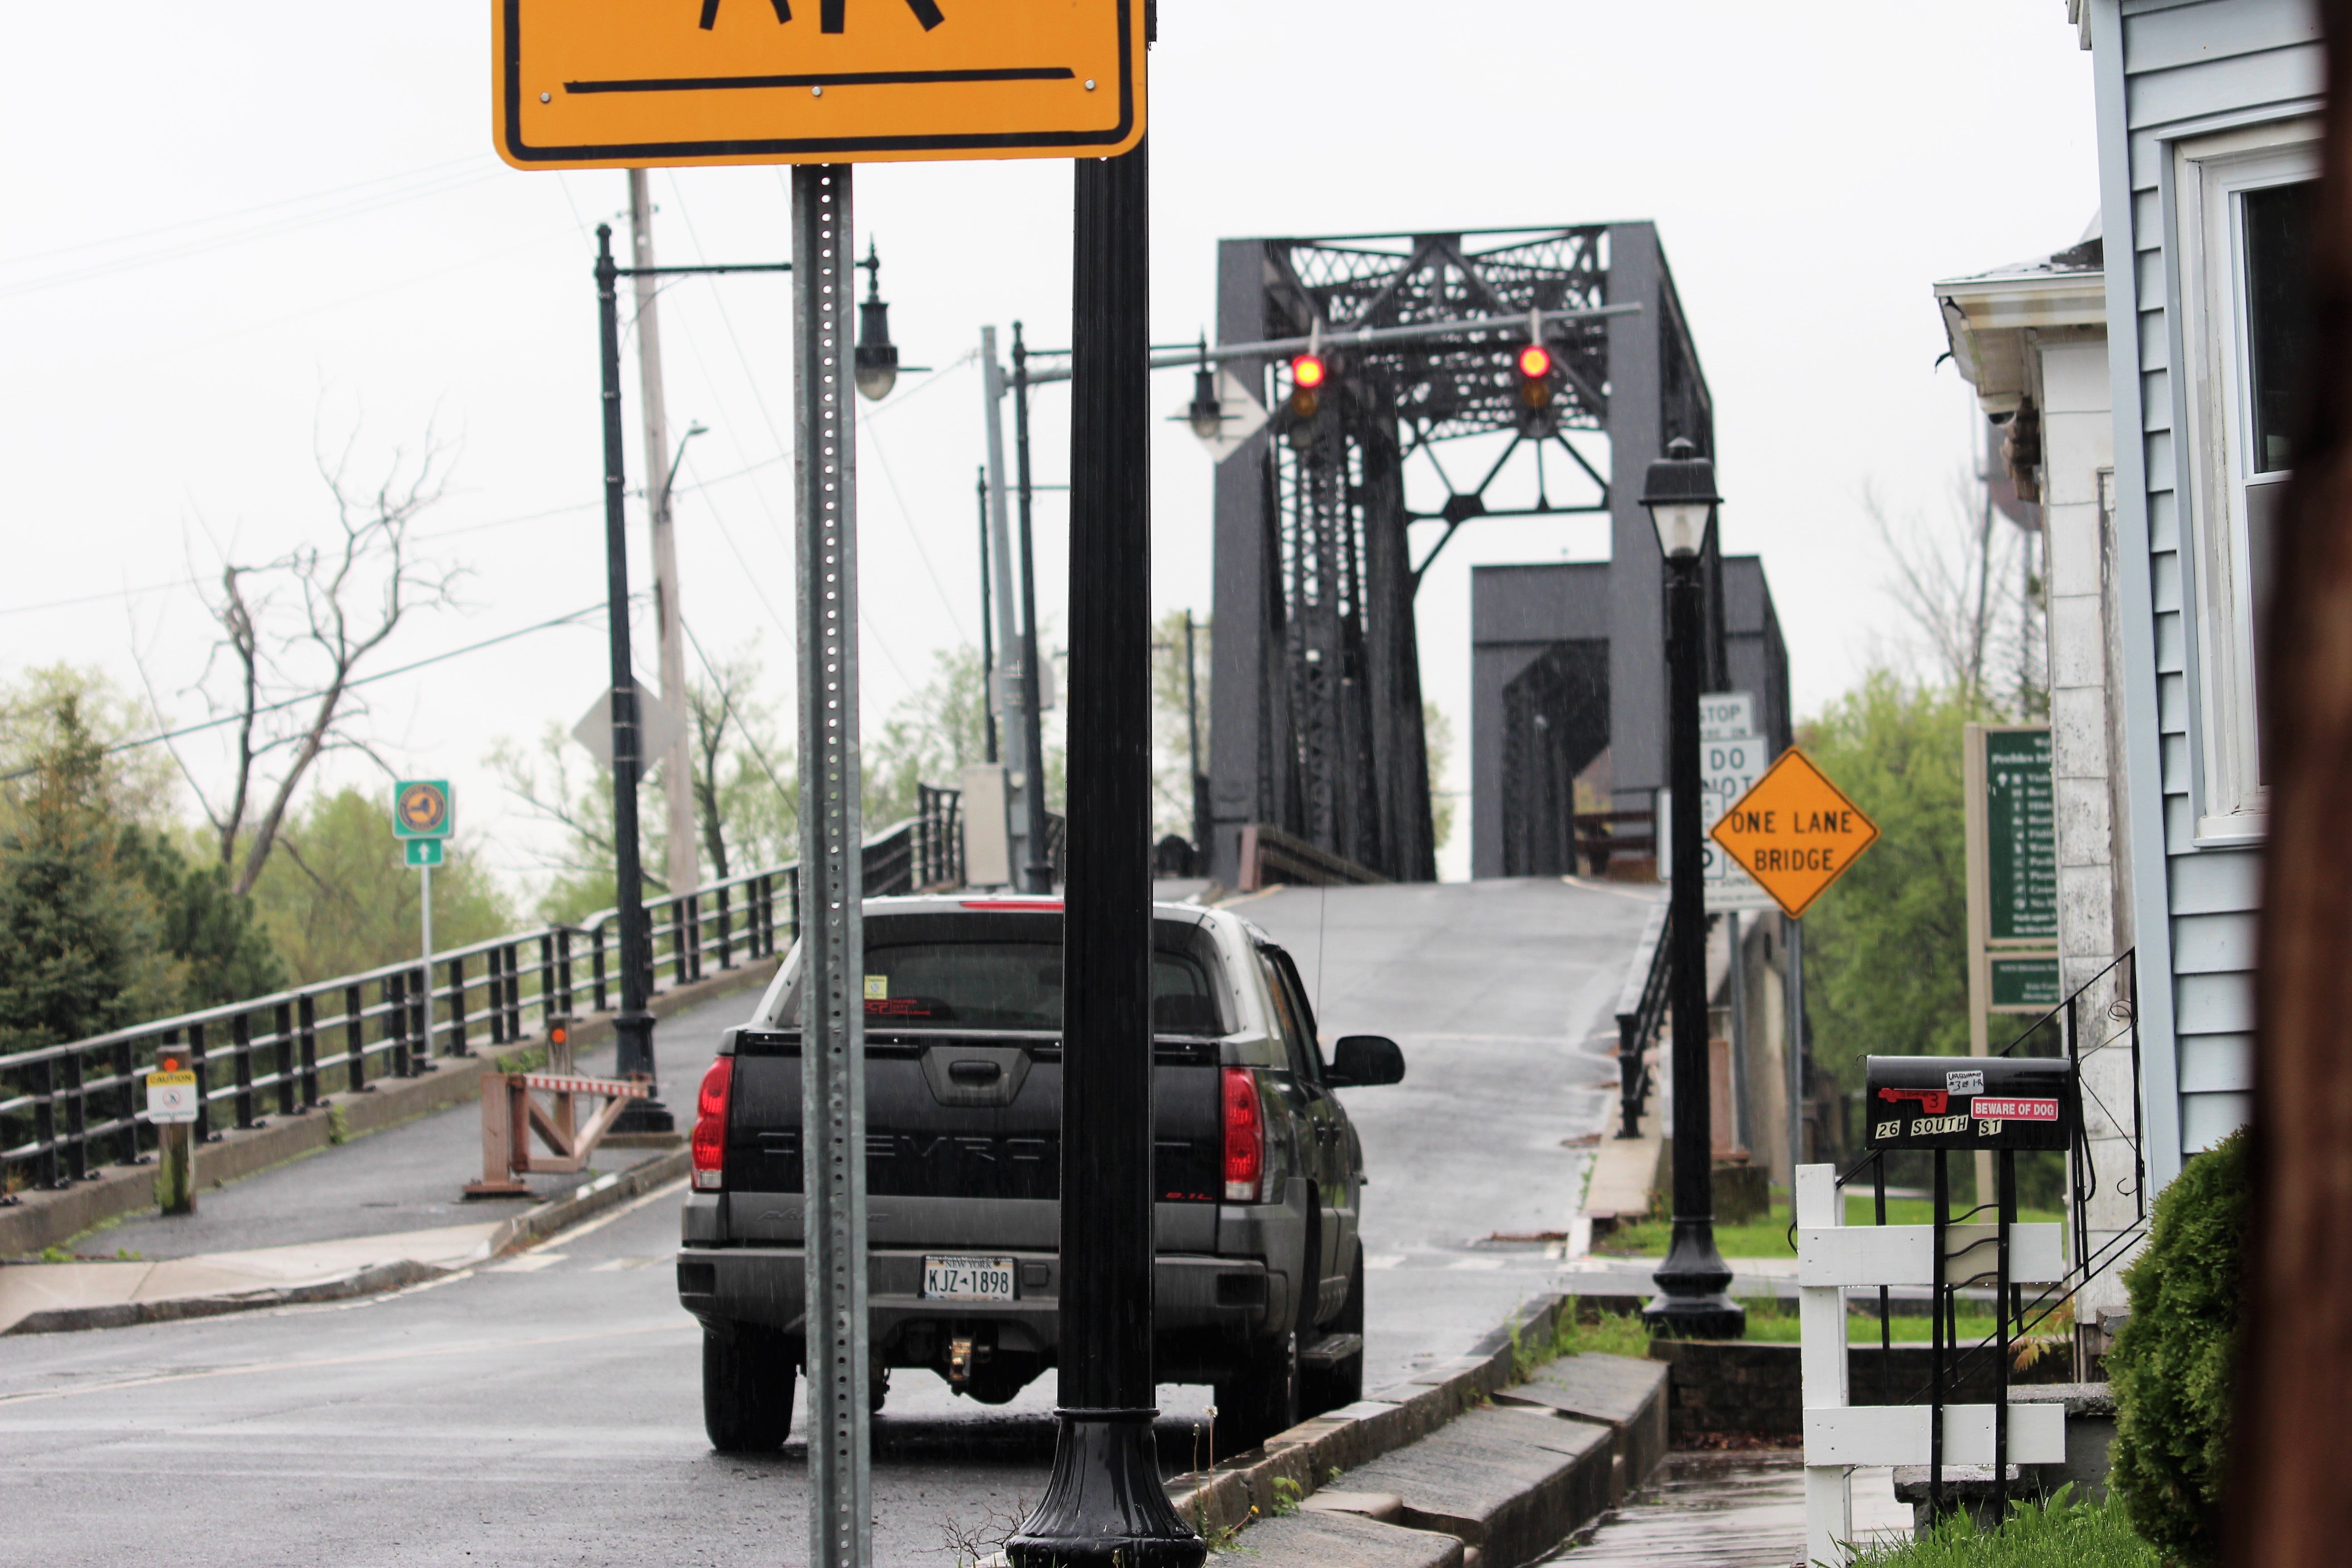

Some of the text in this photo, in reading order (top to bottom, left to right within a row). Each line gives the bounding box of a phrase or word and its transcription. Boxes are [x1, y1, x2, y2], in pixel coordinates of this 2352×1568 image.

[1711, 748, 1744, 770] DO
[1731, 811, 1775, 833] ONE
[1794, 811, 1852, 833] LANE
[1755, 850, 1833, 871] BRIDGE
[150, 1074, 191, 1084] CAUTION
[1929, 1093, 1939, 1108] 3
[1975, 1102, 2054, 1116] BEWARE OF DOG
[1878, 1116, 2001, 1137] 26 SOUTH ST
[946, 1260, 992, 1269] NEW YORK
[929, 1269, 1009, 1294] KJZ 1898
